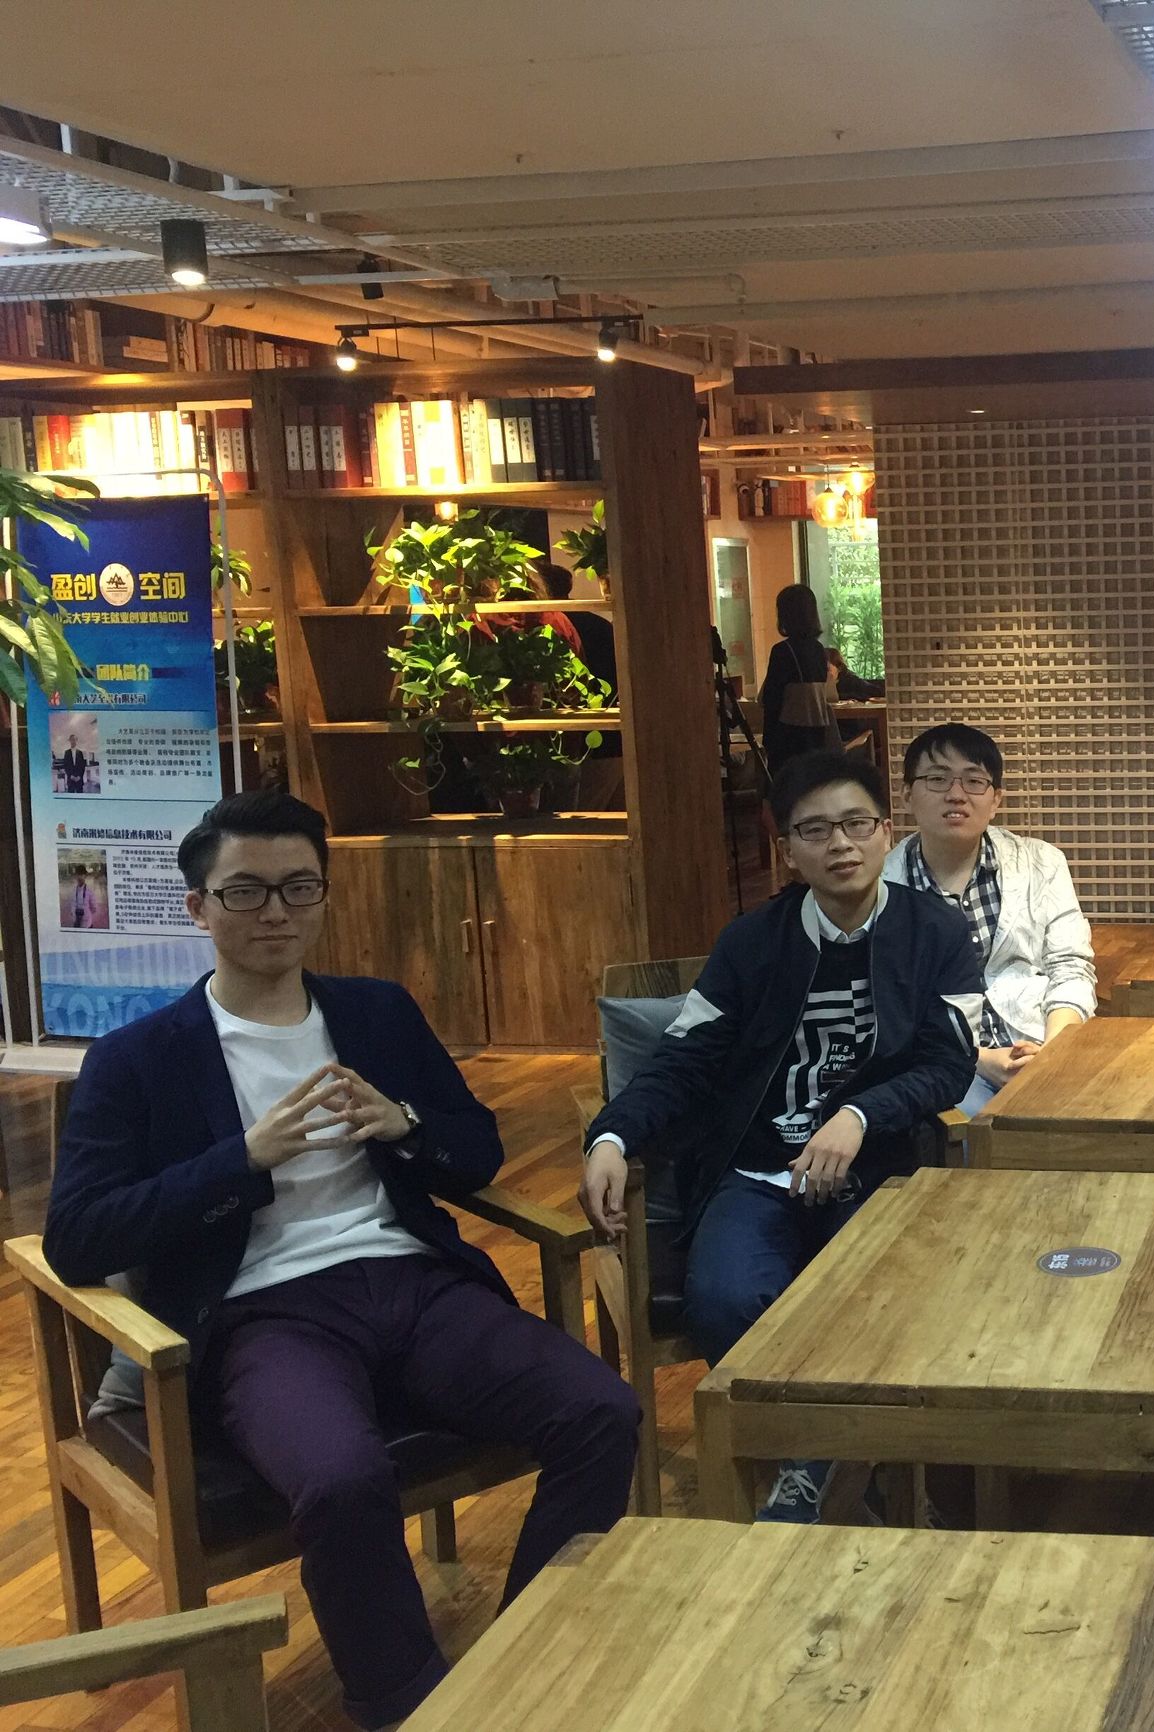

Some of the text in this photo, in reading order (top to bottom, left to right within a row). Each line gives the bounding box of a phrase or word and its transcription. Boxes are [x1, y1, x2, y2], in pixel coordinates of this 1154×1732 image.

[50, 571, 186, 602] 盈创 空间
[96, 663, 151, 681] 团队简介
